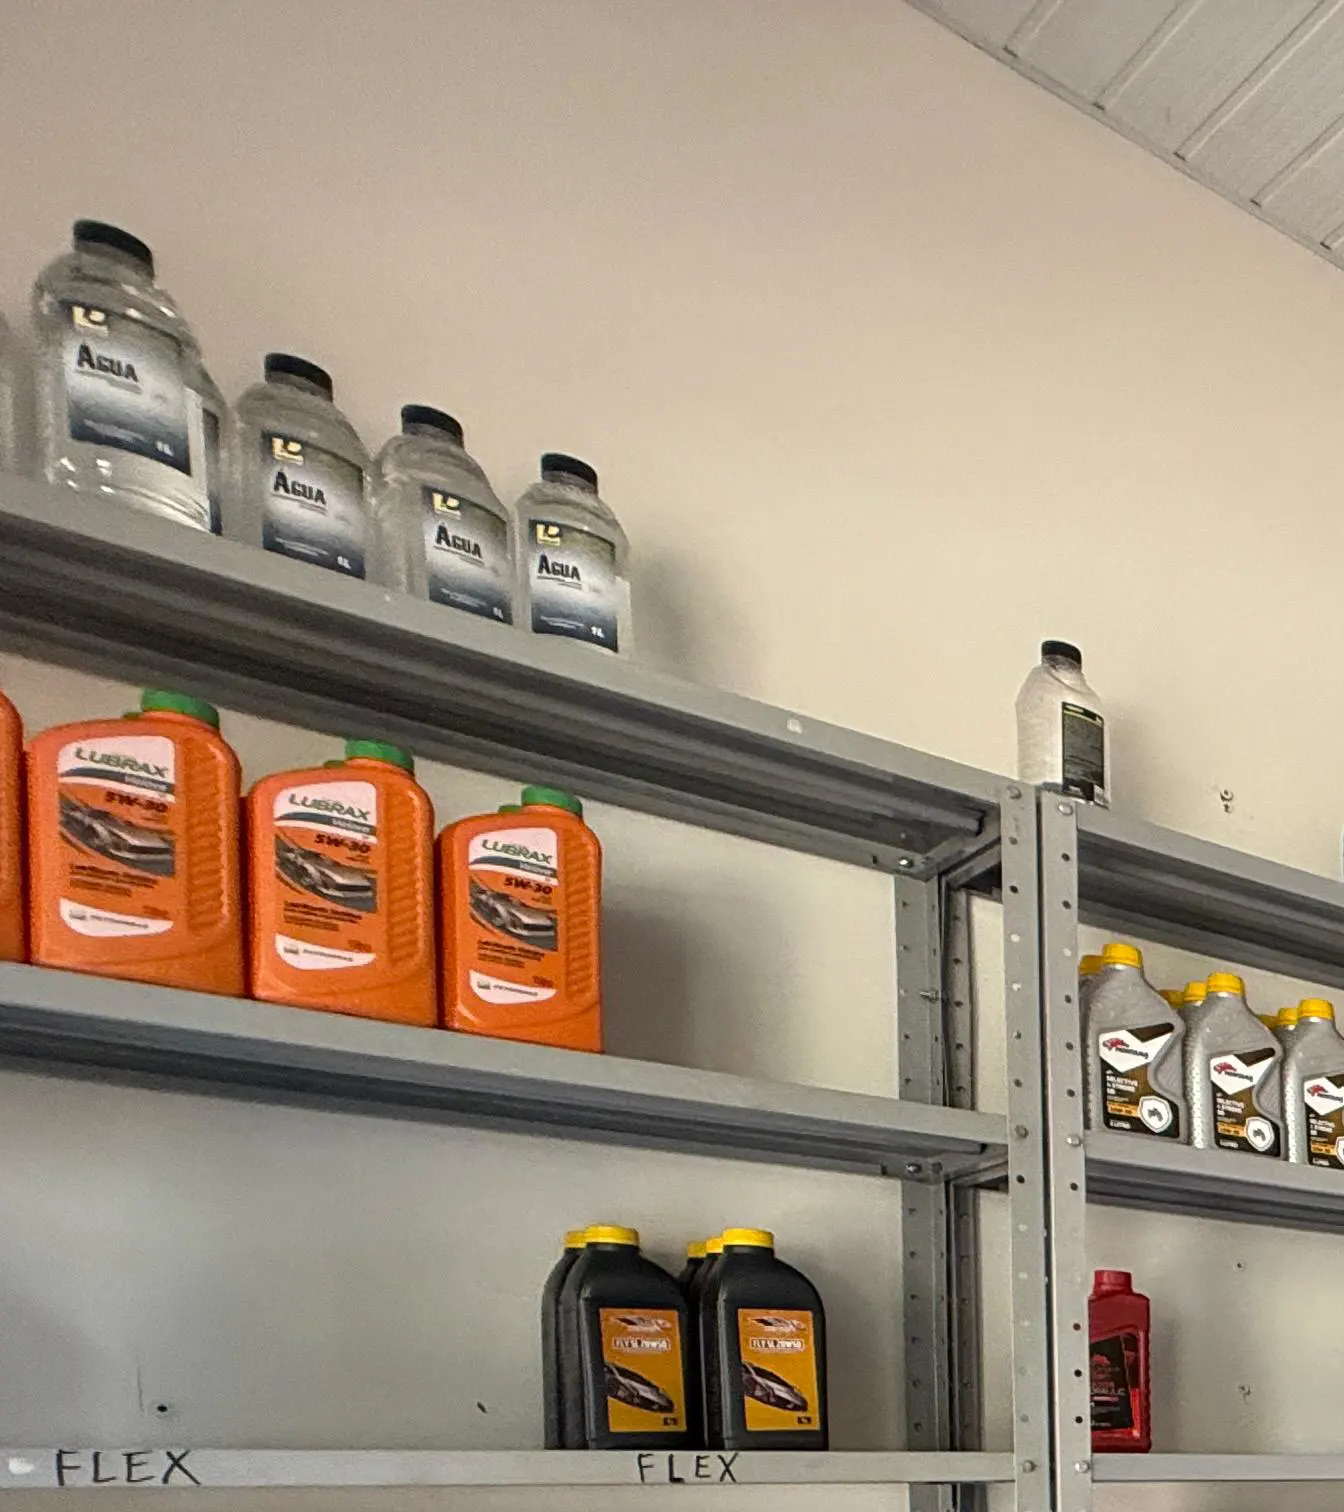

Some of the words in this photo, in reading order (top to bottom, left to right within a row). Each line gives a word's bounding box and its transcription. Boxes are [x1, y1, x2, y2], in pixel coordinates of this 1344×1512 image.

[75, 747, 170, 779] LUBRAX
[287, 793, 371, 822] LUBRAX
[481, 839, 553, 864] LUBRAX
[54, 1449, 202, 1486] FLEX
[637, 1452, 741, 1484] FLEX
